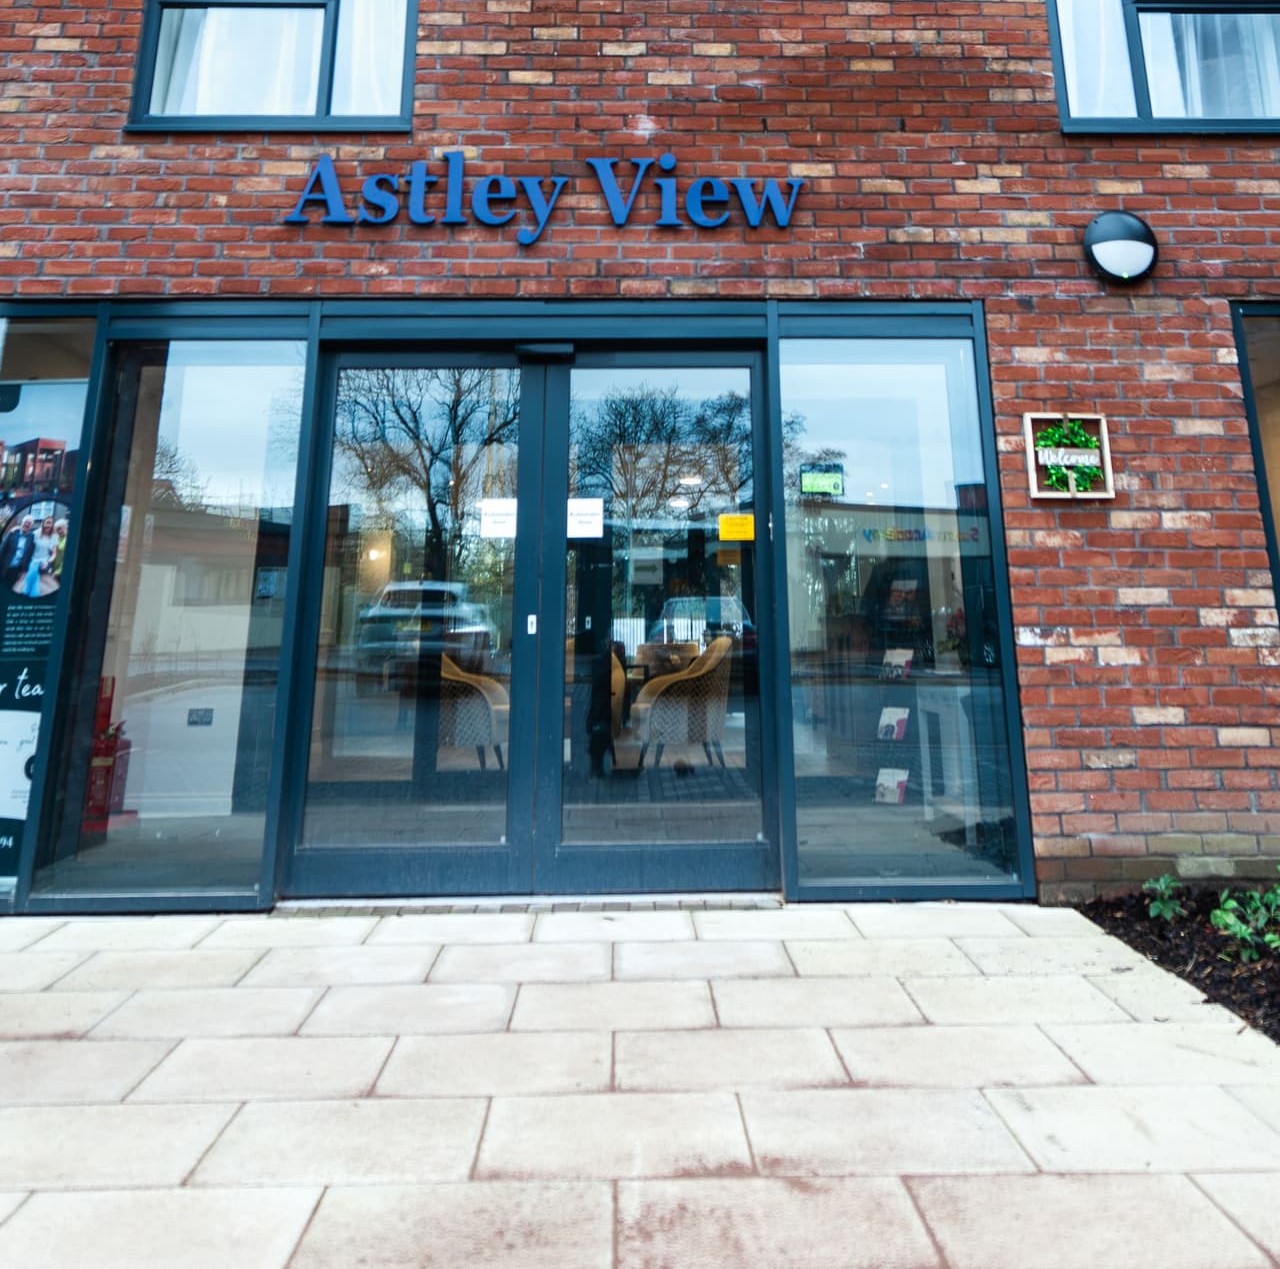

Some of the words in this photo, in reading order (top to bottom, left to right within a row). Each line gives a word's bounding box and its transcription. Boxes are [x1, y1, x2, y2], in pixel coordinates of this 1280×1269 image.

[284, 150, 569, 246] Astley
[585, 151, 806, 230] View
[1038, 448, 1099, 467] Welcome
[14, 666, 45, 700] tea
